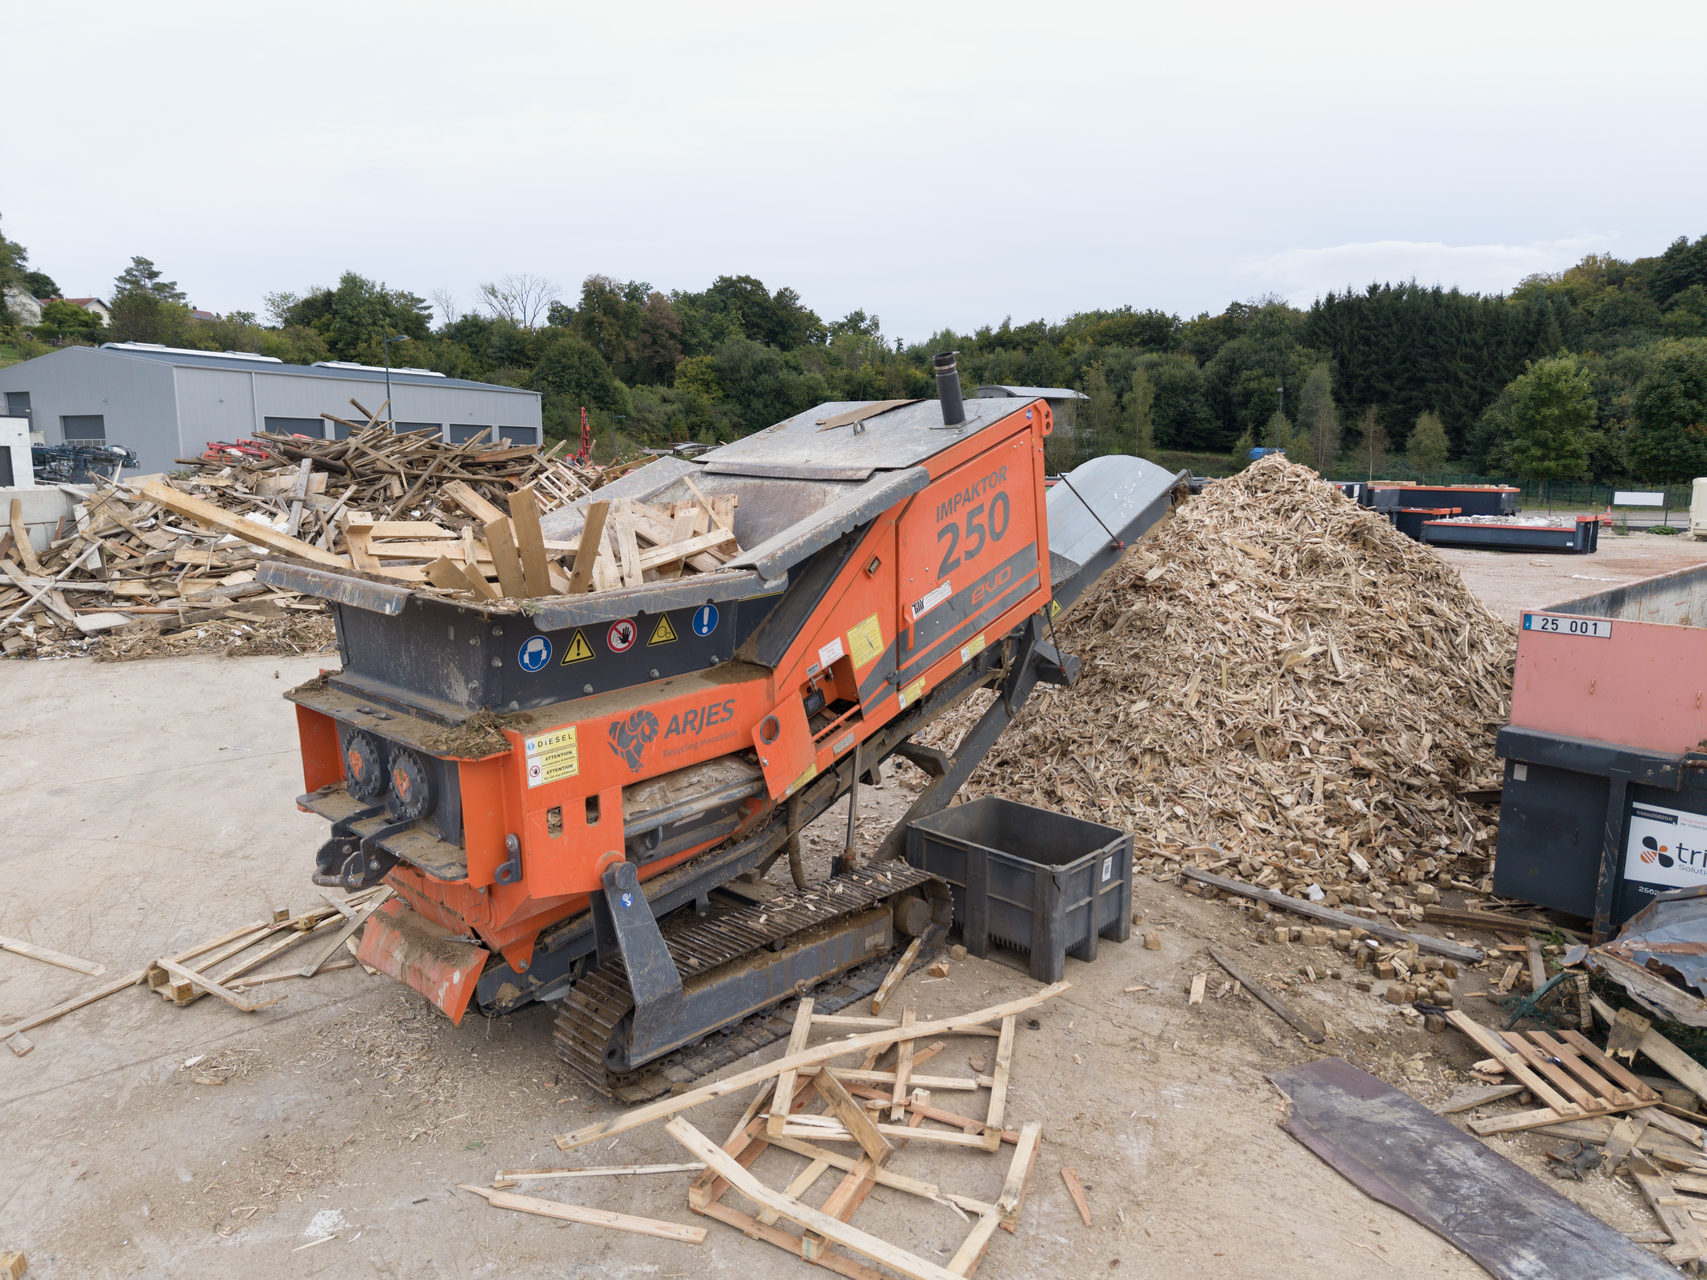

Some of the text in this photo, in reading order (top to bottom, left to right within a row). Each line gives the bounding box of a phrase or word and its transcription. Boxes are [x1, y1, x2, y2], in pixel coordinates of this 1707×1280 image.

[936, 465, 1007, 523] IMPAKTOR
[937, 490, 1010, 581] 250
[1541, 617, 1598, 635] 25 001
[663, 698, 736, 740] ARJES
[537, 733, 573, 748] DIESEL
[663, 730, 738, 758] Recycling Innovation
[545, 750, 573, 761] ATTENTION
[546, 763, 574, 775] ATTENTION
